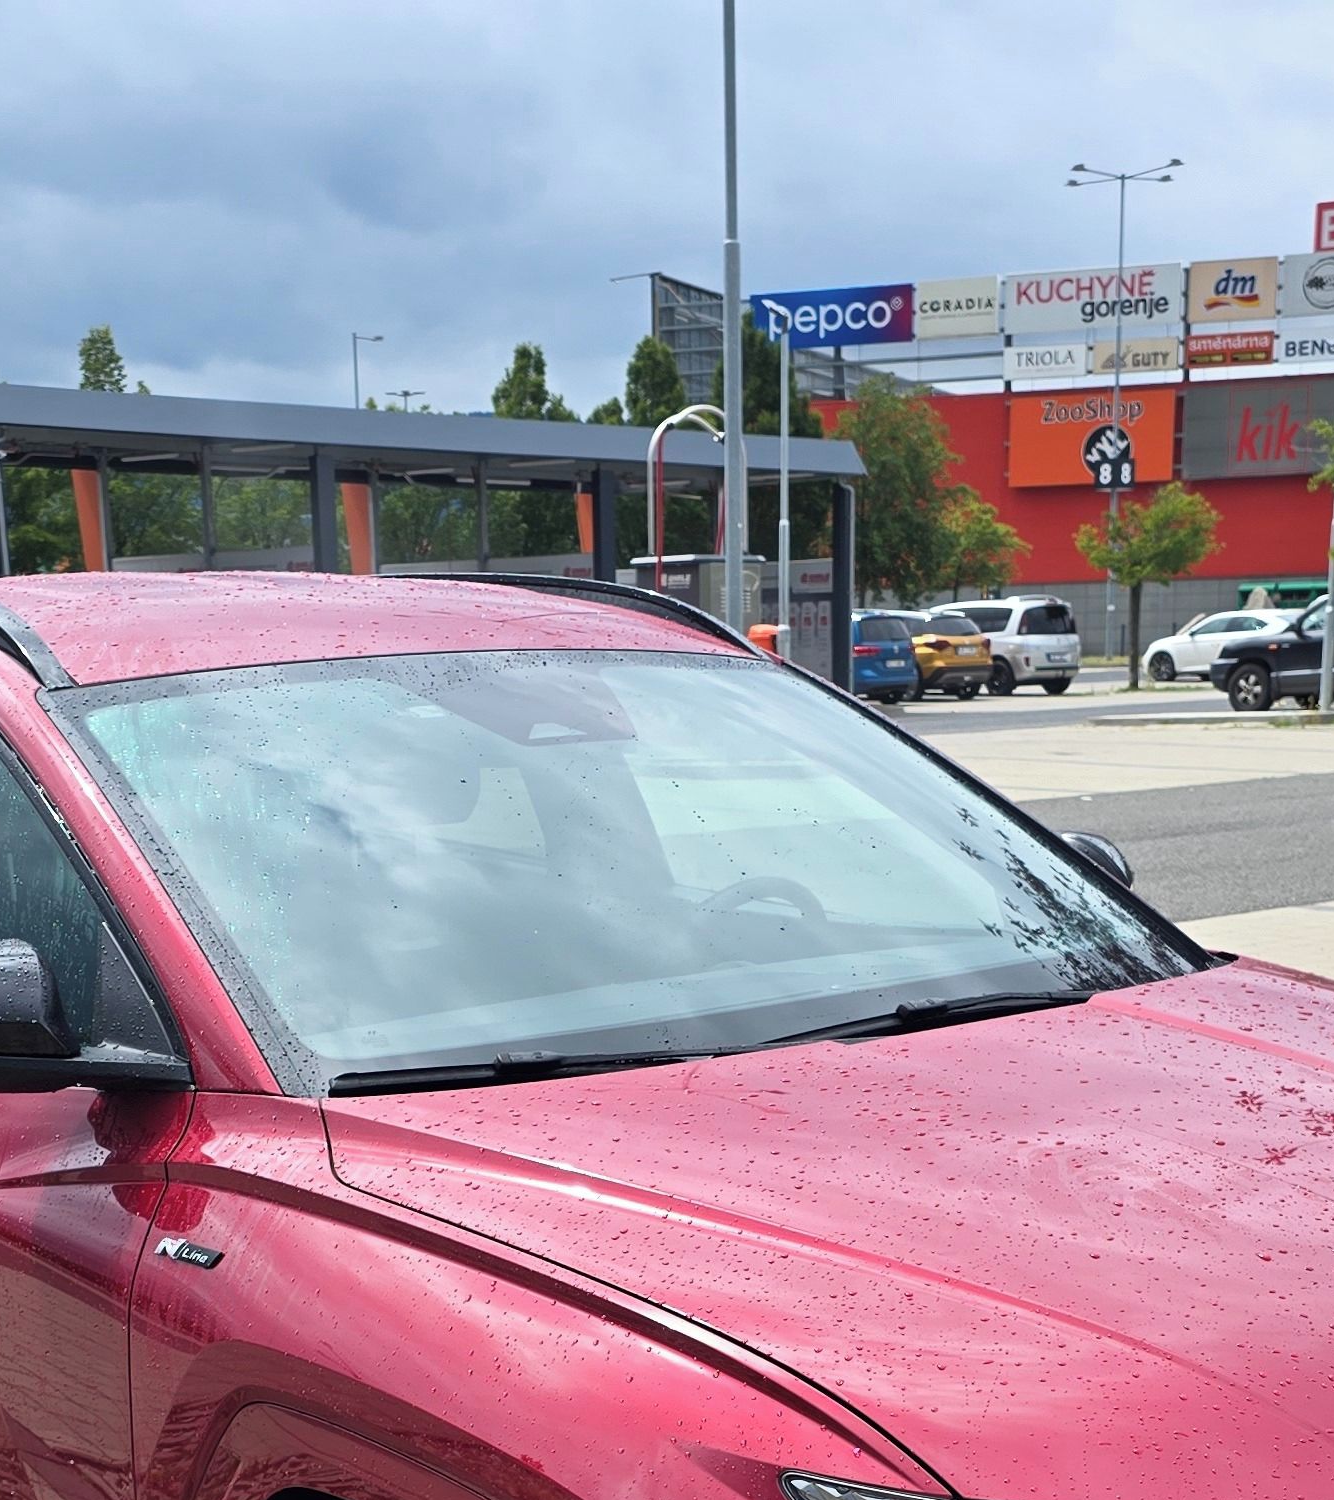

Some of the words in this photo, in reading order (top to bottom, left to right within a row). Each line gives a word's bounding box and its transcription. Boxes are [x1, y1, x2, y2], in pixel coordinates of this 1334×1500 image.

[1016, 270, 1155, 305] KUCHYNĚ
[1214, 269, 1256, 296] dm
[920, 297, 994, 315] CORADIA
[1081, 292, 1169, 323] gorenje
[769, 300, 892, 341] pepco
[1016, 350, 1075, 368] TRIOLA
[1132, 351, 1171, 367] GUTY
[1040, 397, 1145, 425] ZooShop
[1236, 402, 1302, 463] kik
[1099, 462, 1112, 485] 8
[1120, 461, 1132, 485] 8
